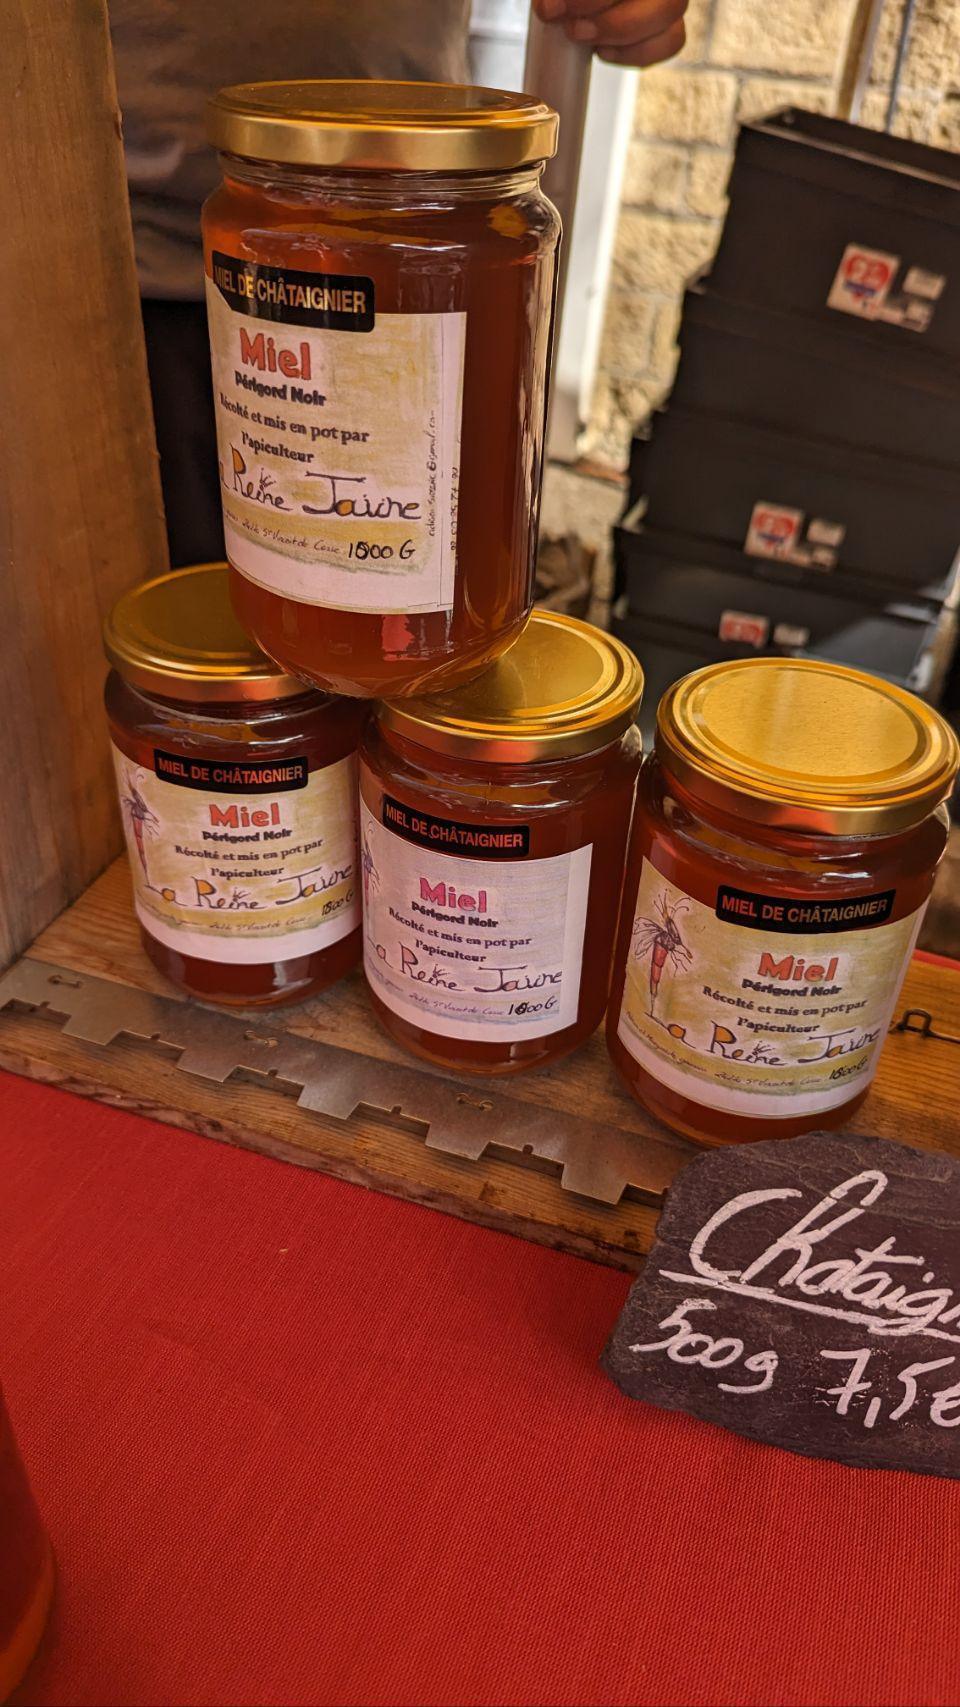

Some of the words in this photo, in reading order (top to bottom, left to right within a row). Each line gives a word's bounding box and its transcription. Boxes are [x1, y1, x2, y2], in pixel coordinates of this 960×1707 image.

[213, 265, 237, 293] MIEL
[238, 275, 254, 298] DE
[256, 277, 366, 313] CHÂTAIGNIER
[240, 327, 311, 380] Miel
[235, 371, 287, 401] Périgord
[291, 386, 327, 406] Noir
[220, 393, 249, 418] Récolté
[251, 411, 262, 423] et
[264, 416, 286, 431] mis
[290, 422, 307, 435] en
[311, 426, 338, 441] pot
[341, 430, 370, 445] par
[241, 430, 315, 463] l'apiculteur
[229, 443, 293, 511] Reine
[302, 471, 422, 520] Jaune
[158, 758, 188, 778] MIEL
[191, 766, 209, 782] DE
[213, 765, 303, 785] CHÂTAIGNIER
[209, 802, 281, 829] Miel
[385, 803, 410, 829] MIEL
[411, 820, 427, 836] DE
[429, 825, 524, 848] CHÂTAIGNIER
[174, 844, 219, 861] Récolté
[222, 853, 236, 862] et
[237, 849, 259, 861] mis
[263, 851, 279, 860] en
[281, 845, 303, 862] pot
[304, 838, 323, 855] par
[202, 831, 260, 845] Périgord
[263, 828, 293, 842] Noir
[192, 876, 268, 910] Reine
[275, 864, 353, 905] Jaune
[210, 866, 285, 880] l'apiculteur
[419, 877, 488, 914] Miel
[722, 895, 757, 918] MIEL
[762, 904, 783, 922] DE
[788, 898, 888, 924] CHÂTAIGNIER
[388, 907, 425, 934] Récolté
[427, 928, 440, 938] et
[441, 932, 463, 944] mis
[466, 937, 482, 946] en
[484, 938, 507, 949] pot
[509, 937, 532, 949] par
[411, 901, 465, 925] Périgord
[468, 915, 499, 928] Noir
[398, 941, 466, 992] Reine
[474, 965, 563, 993] Jaune
[415, 938, 488, 963] l'apiculteur
[757, 952, 839, 983] Miel
[702, 986, 754, 1011] Récolté
[758, 1002, 772, 1014] et
[774, 1002, 800, 1016] mis
[802, 1005, 819, 1015] en
[821, 1004, 846, 1019] pot
[846, 999, 868, 1015] par
[741, 978, 807, 998] Périgord
[810, 984, 843, 997] Noir
[736, 1016, 821, 1034] l'apiculteur
[704, 1018, 788, 1067] Reine
[797, 1025, 883, 1065] Jaune
